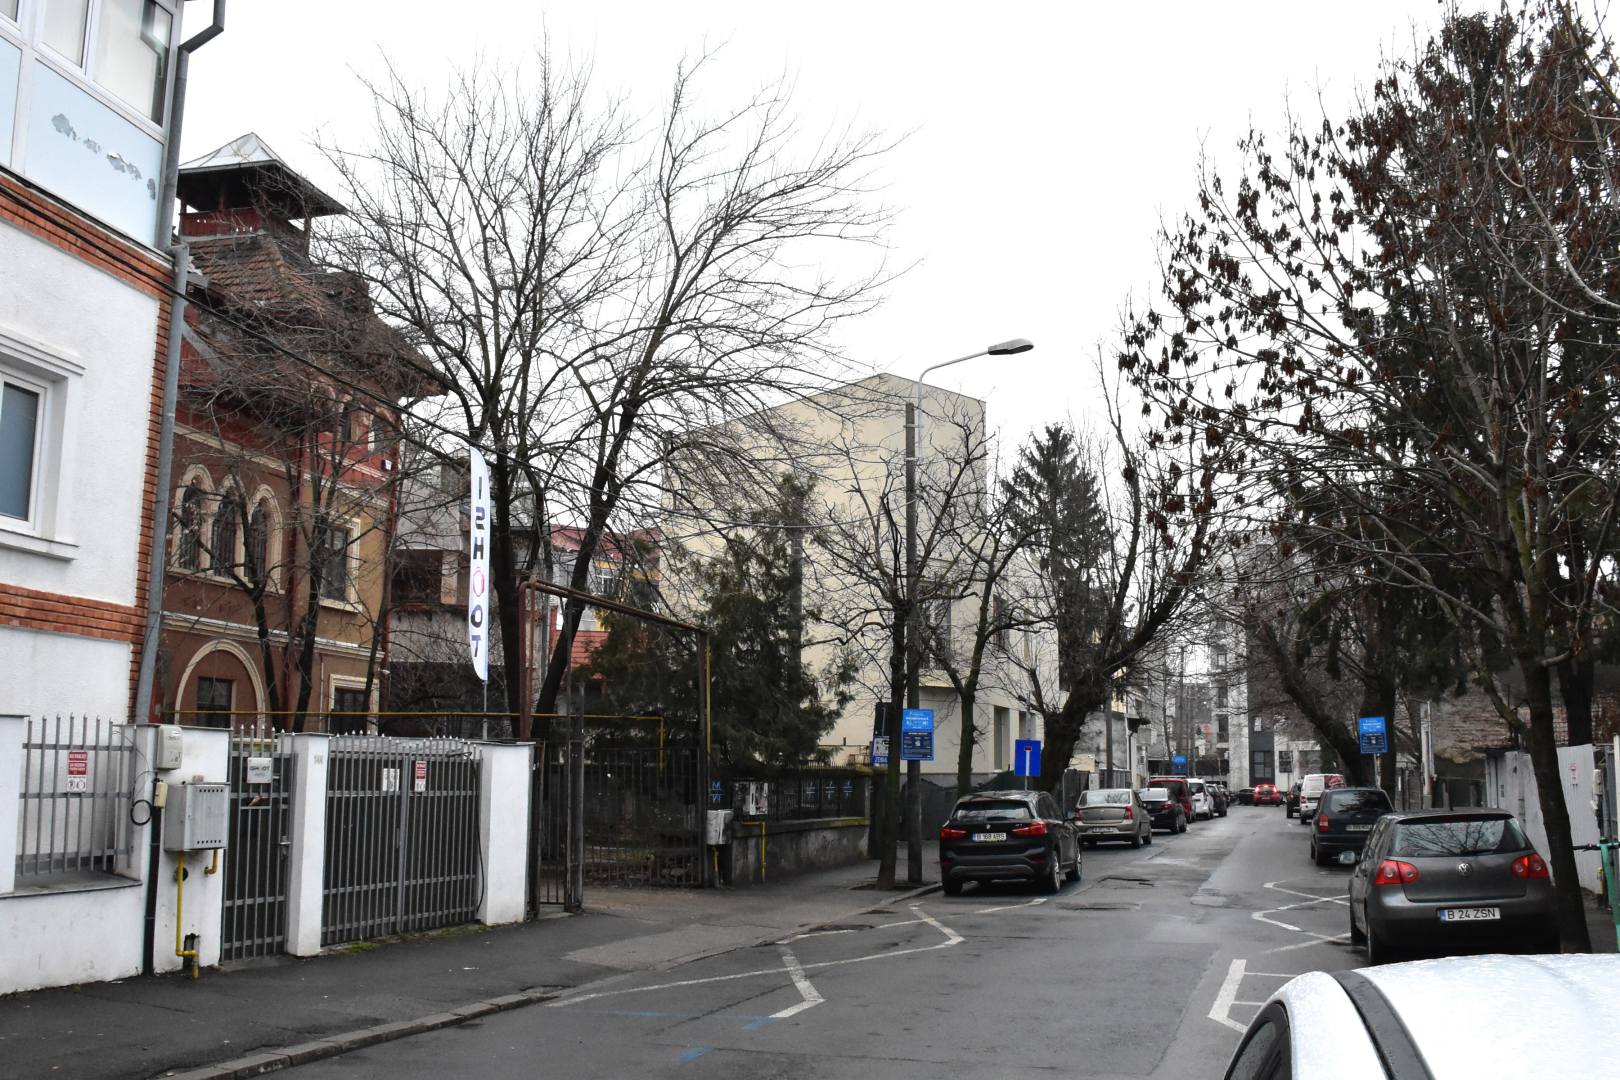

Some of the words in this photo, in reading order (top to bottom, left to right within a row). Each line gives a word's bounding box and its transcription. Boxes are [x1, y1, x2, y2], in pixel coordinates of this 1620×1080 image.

[1447, 910, 1455, 920] B
[1458, 909, 1471, 919] 24
[1473, 908, 1496, 918] ZSN
